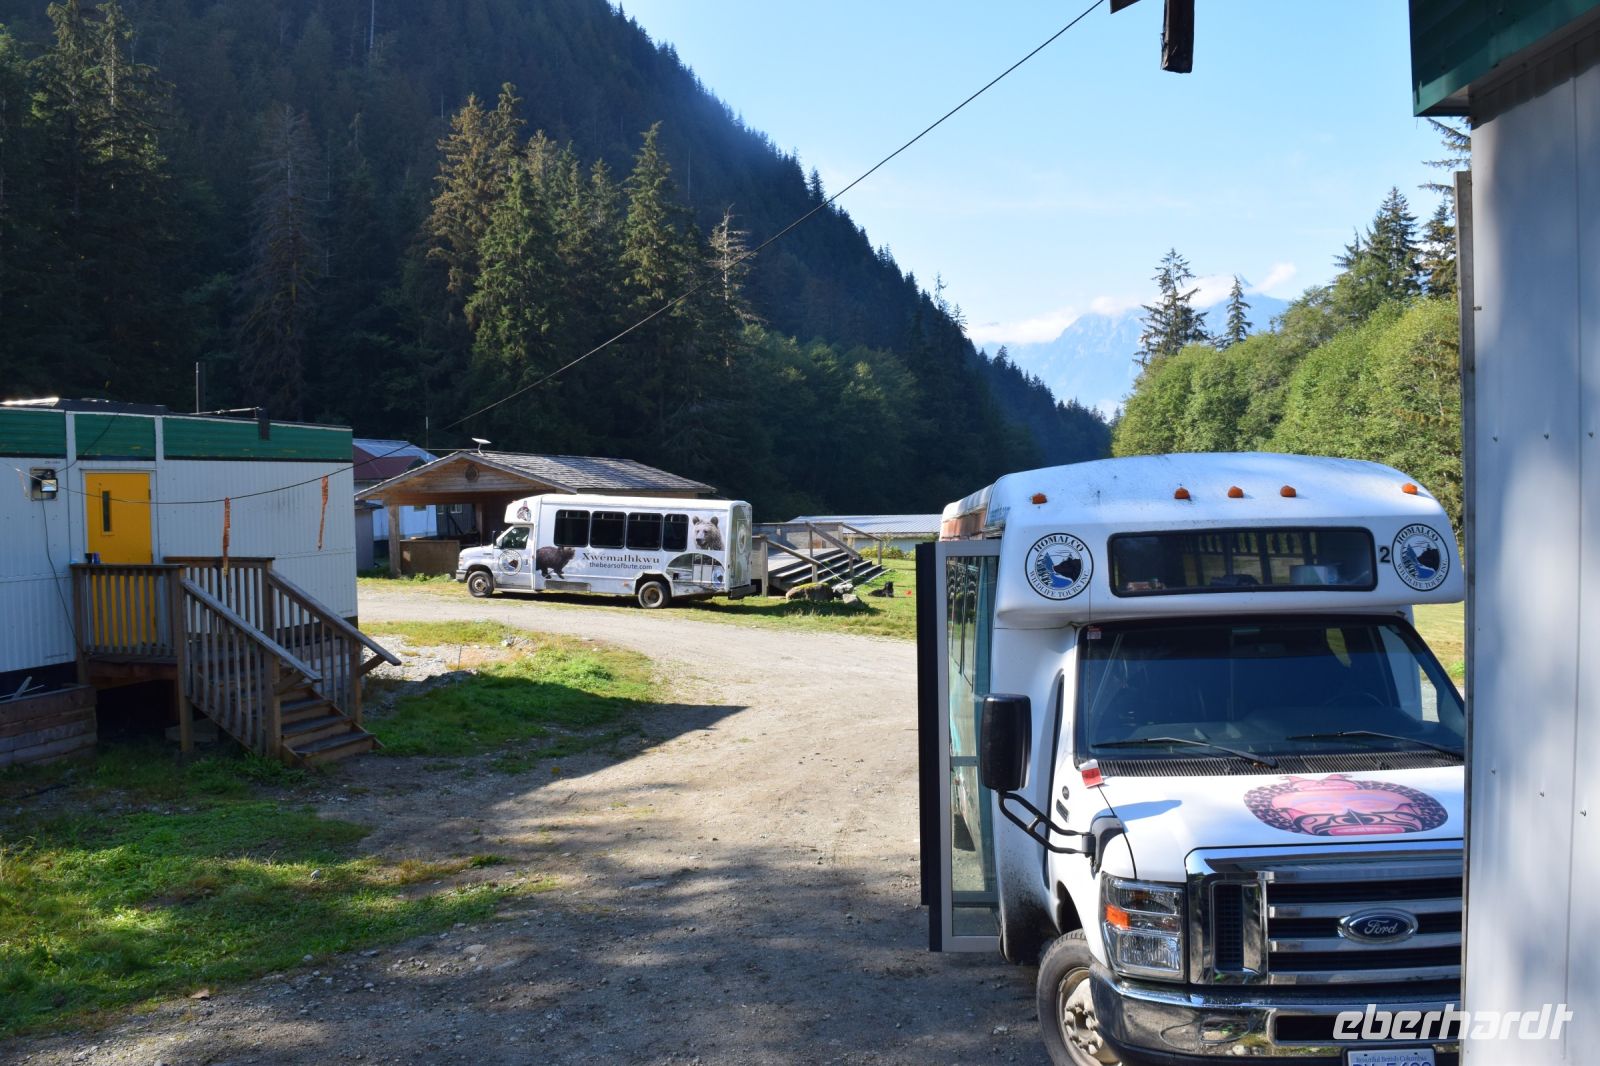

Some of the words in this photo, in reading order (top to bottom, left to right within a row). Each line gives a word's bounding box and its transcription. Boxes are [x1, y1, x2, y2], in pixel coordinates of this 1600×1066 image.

[1033, 535, 1084, 553] HOMALCO
[1396, 526, 1439, 545] HOMALCO
[1379, 546, 1391, 563] 2
[1029, 570, 1056, 598] WILDLIFE
[1057, 584, 1082, 598] TOURS
[1397, 562, 1423, 589] WILDLIFE
[1424, 574, 1443, 589] TOURS
[1363, 919, 1398, 935] Ford
